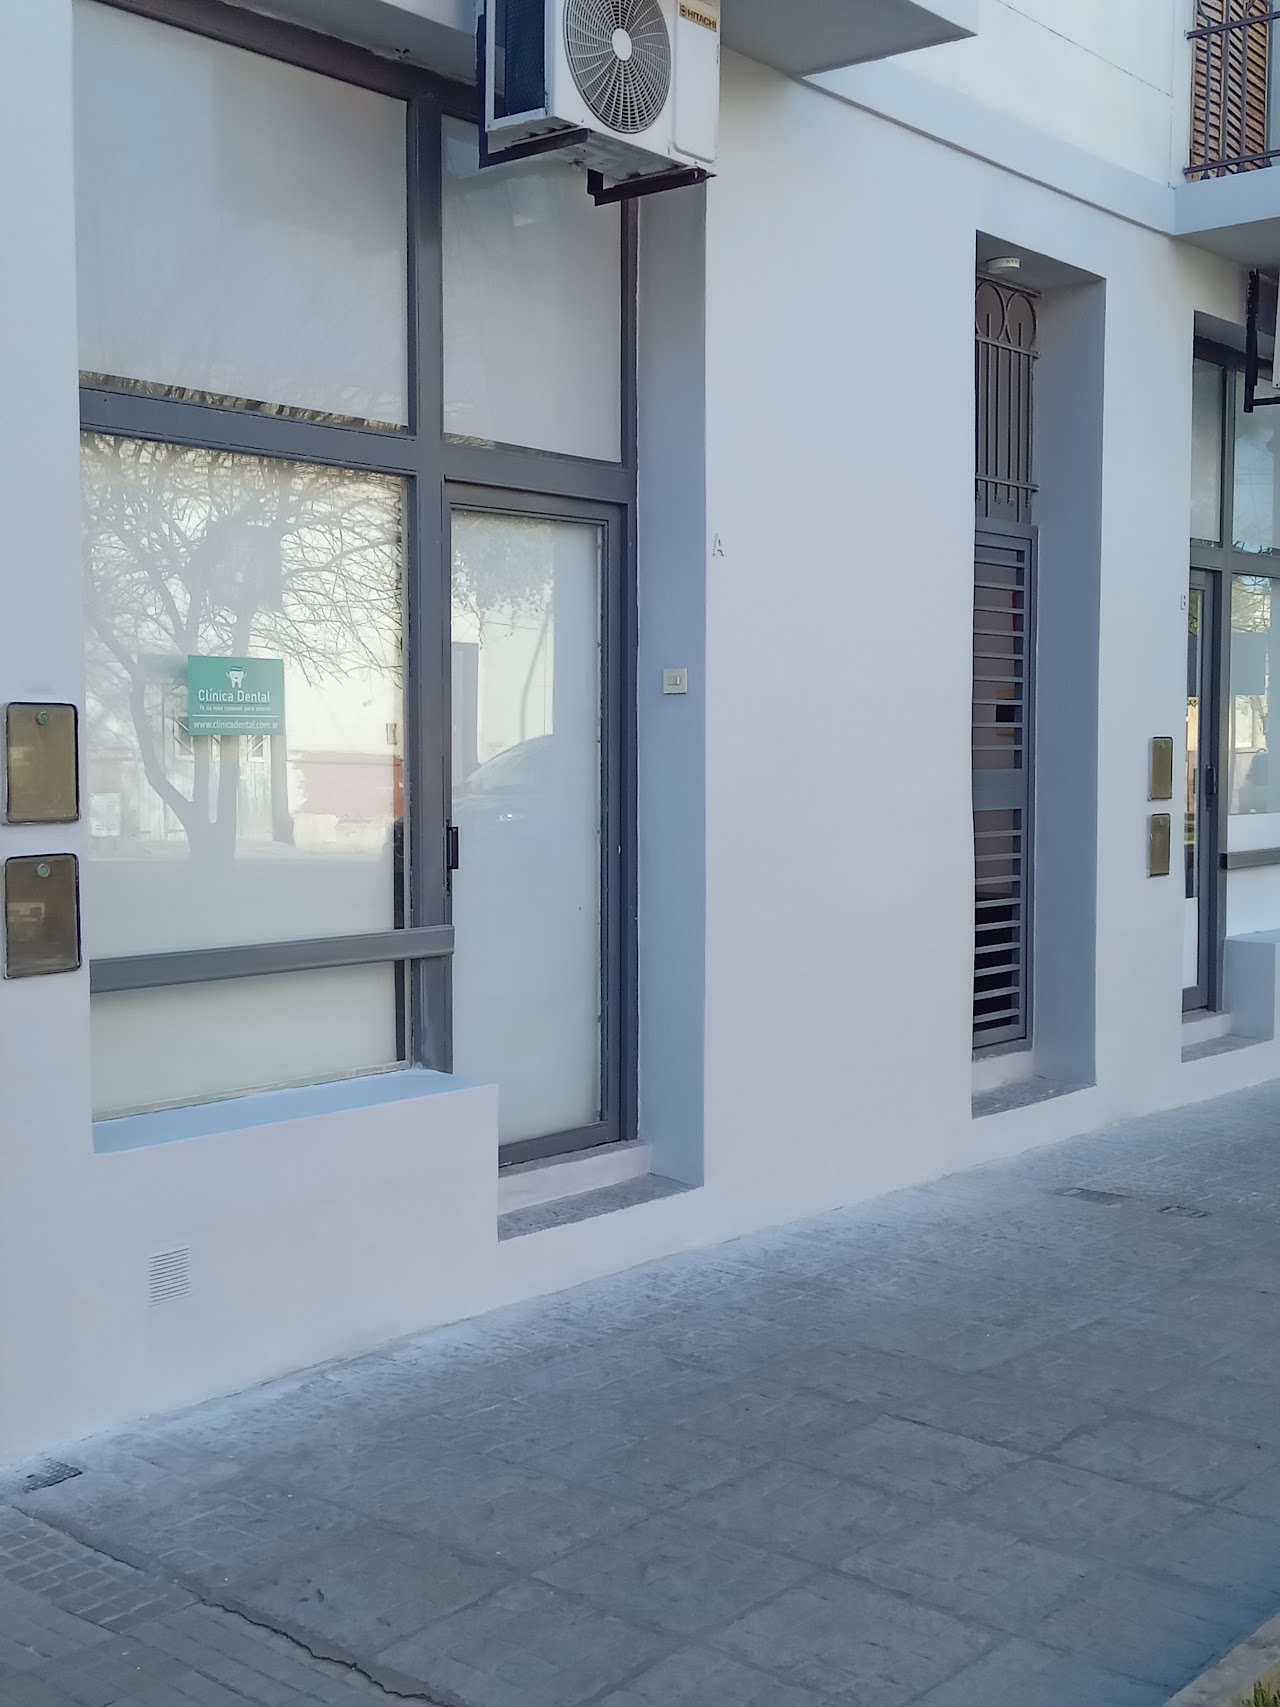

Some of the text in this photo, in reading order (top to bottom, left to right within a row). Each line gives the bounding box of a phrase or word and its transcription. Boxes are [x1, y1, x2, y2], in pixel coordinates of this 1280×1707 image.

[687, 9, 717, 28] HITACHI
[712, 532, 725, 557] A
[198, 688, 270, 702] Clínica Dental
